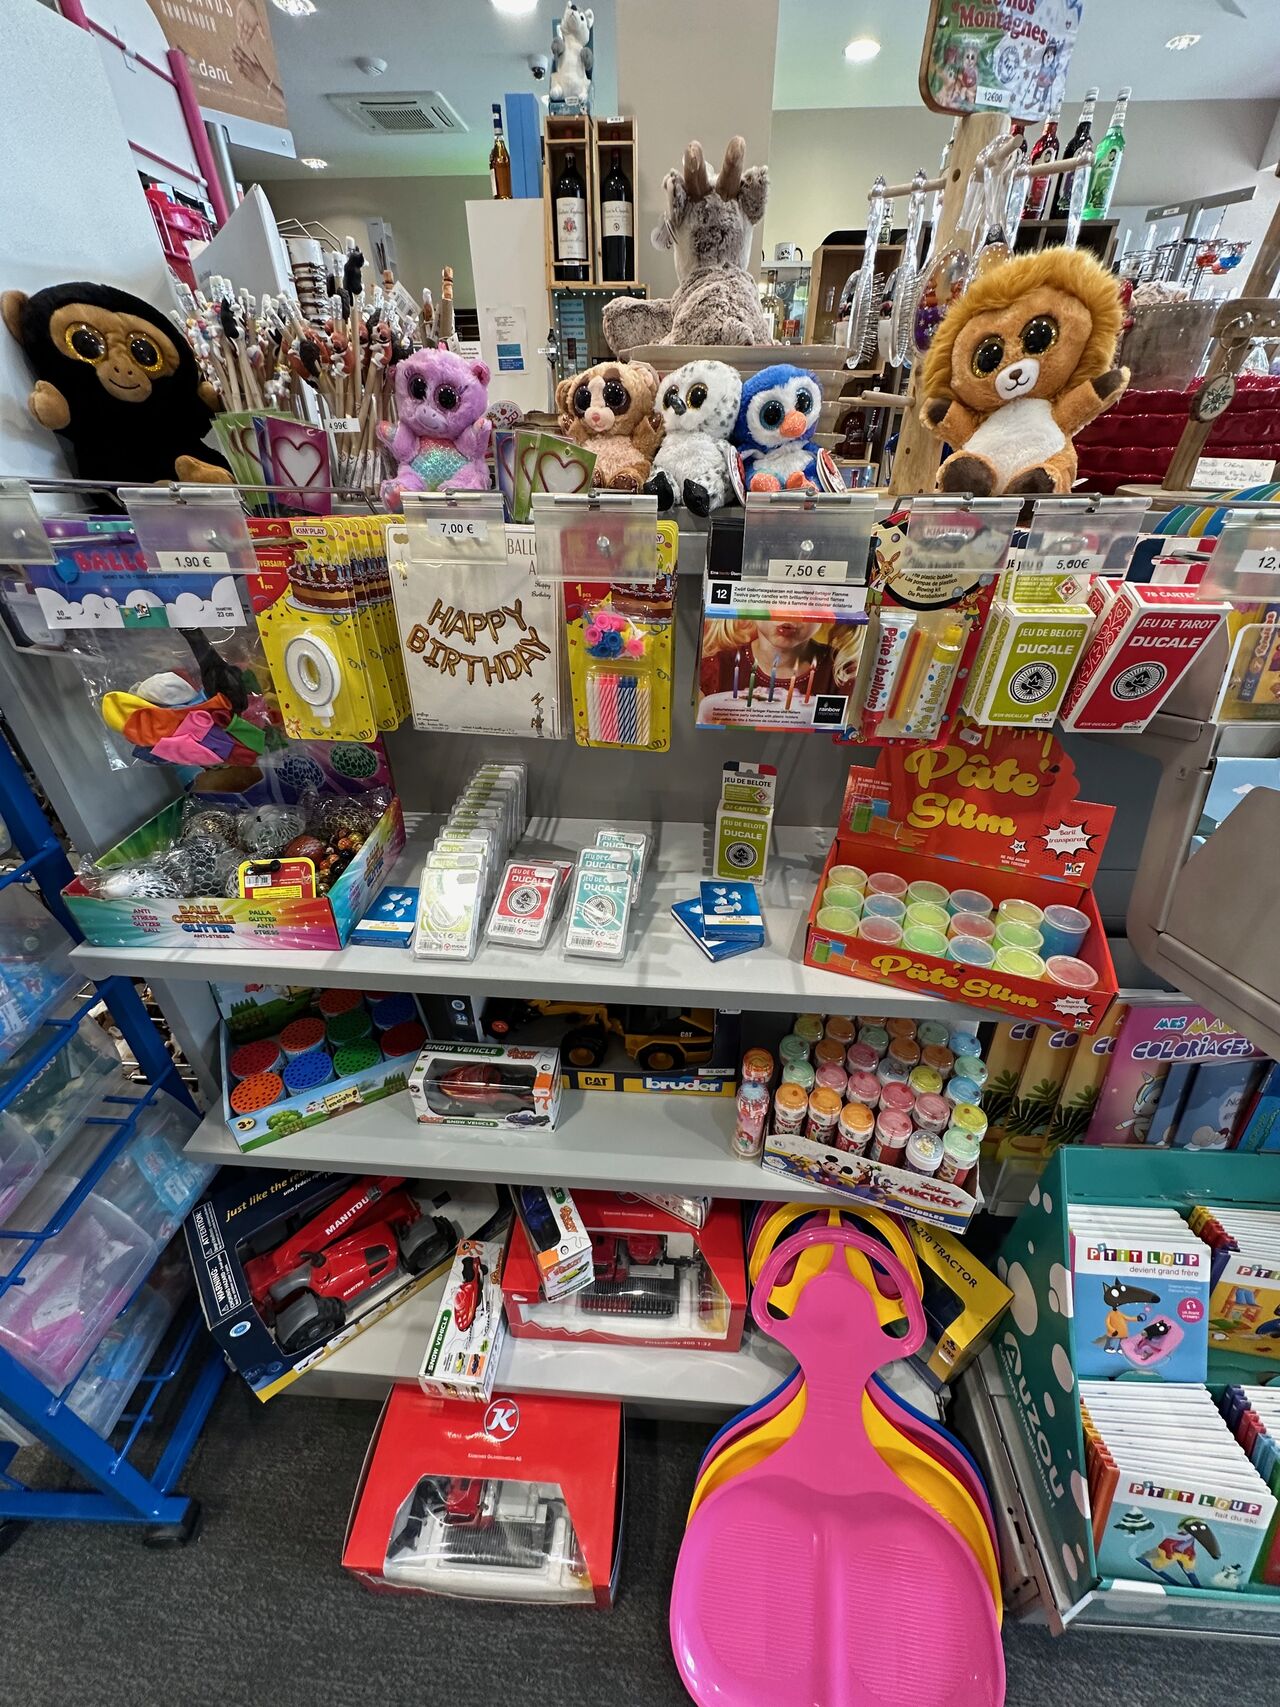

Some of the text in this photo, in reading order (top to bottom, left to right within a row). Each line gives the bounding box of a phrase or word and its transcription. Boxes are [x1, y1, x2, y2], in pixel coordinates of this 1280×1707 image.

[952, 4, 1048, 45] Montagnes
[440, 523, 474, 534] 7,00 €
[507, 538, 538, 555] BALL
[174, 556, 212, 568] 1,90 €
[785, 565, 826, 577] 7,50 €
[257, 577, 265, 589] 1
[575, 584, 582, 596] 1
[716, 589, 727, 599] 12
[427, 598, 527, 645] HAPPY
[1137, 618, 1217, 629] JEU DE TAROT
[1019, 628, 1083, 638] JEU DE BELOTE
[880, 627, 898, 656] Pâte
[1129, 636, 1203, 648] DUCALE
[406, 624, 551, 686] BIRTHDAY
[1016, 644, 1075, 655] DUCALE
[867, 668, 889, 709] ballons
[904, 745, 1040, 796] Pâte
[746, 779, 772, 788] BELOTE
[907, 793, 1017, 836] Slim
[724, 829, 762, 840] DUCALE
[583, 883, 623, 893] DUCALE
[870, 955, 960, 989] Pâte
[1154, 1016, 1187, 1030] MES
[457, 1046, 498, 1055] VEHICLE
[585, 1076, 608, 1086] CAT
[645, 1077, 720, 1092] bruder
[237, 1120, 253, 1130] 3+
[226, 1181, 288, 1222] just like the
[898, 1186, 968, 1208] MICKEY
[325, 1196, 370, 1236] MANITOU
[904, 1205, 945, 1221] BUBBLES
[932, 1241, 978, 1288] TRACTOR
[1147, 1250, 1200, 1267] LOUP
[1129, 1266, 1199, 1277] devient grand frère
[428, 1316, 449, 1371] SNOW VEHICLE
[486, 1407, 517, 1432] K
[1198, 1494, 1262, 1516] LOUP
[1215, 1511, 1229, 1520] fait
[1230, 1514, 1242, 1522] du
